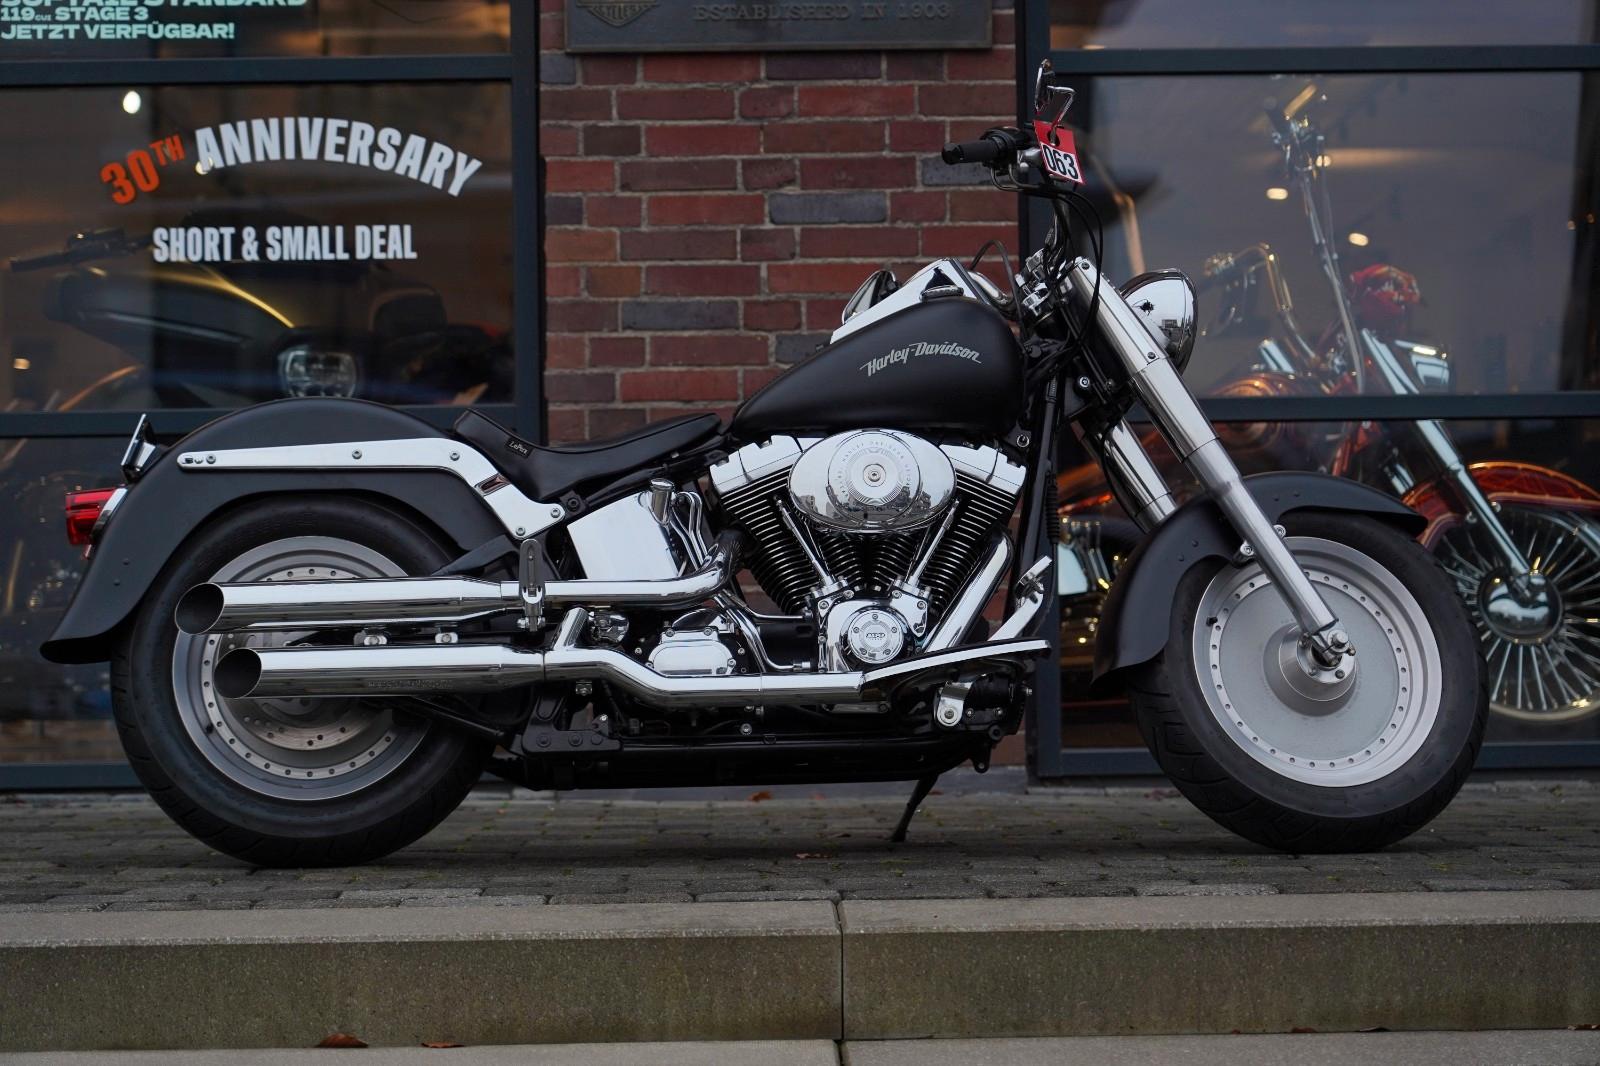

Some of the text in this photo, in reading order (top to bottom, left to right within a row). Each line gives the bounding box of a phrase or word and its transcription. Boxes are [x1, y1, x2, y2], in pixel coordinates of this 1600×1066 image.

[55, 7, 130, 21] STAGE
[134, 7, 149, 21] 3
[693, 2, 952, 21] ESTABLISHED IN 1903
[1, 22, 235, 40] JETZT VERFÜGBAR!
[194, 116, 483, 198] ANNIVERSARY
[1042, 144, 1079, 180] 063
[152, 224, 418, 263] SHORT & SMALL DEAL
[859, 341, 982, 377] Harley-Davidson
